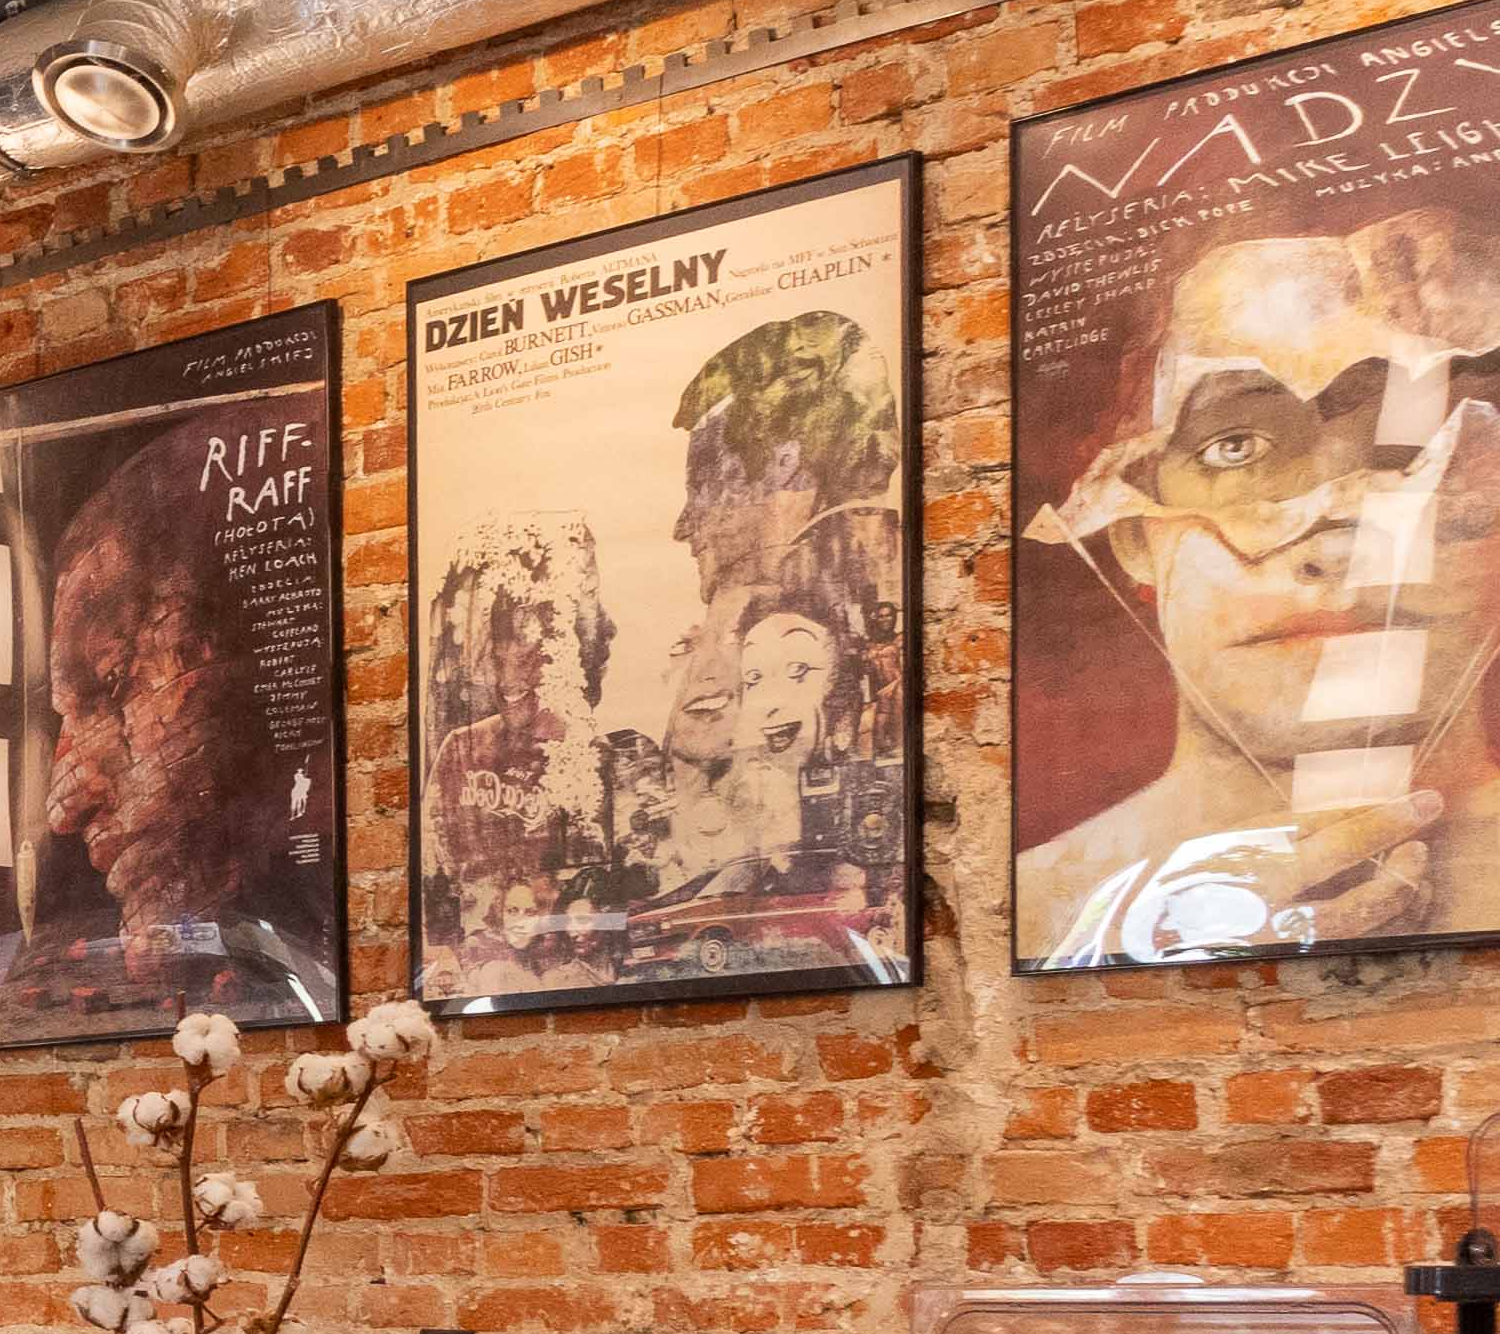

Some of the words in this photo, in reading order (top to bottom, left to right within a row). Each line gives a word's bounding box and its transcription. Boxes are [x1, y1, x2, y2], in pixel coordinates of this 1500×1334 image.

[1041, 114, 1129, 160] FILM
[1227, 153, 1371, 196] MIKE
[777, 252, 873, 291] CHAPLIN
[1022, 282, 1081, 307] DAVID
[1084, 258, 1163, 288] THEWLIS
[425, 298, 525, 354] DZIEŃ
[540, 248, 728, 323] WESELNY
[1025, 297, 1086, 322] LESLEY
[1094, 277, 1157, 306] SHARP
[1022, 327, 1110, 362] CARTLIDGE
[1024, 317, 1087, 344] KATRIN
[550, 342, 593, 367] GISH
[226, 466, 313, 523] RAFF
[265, 552, 318, 572] LOACH
